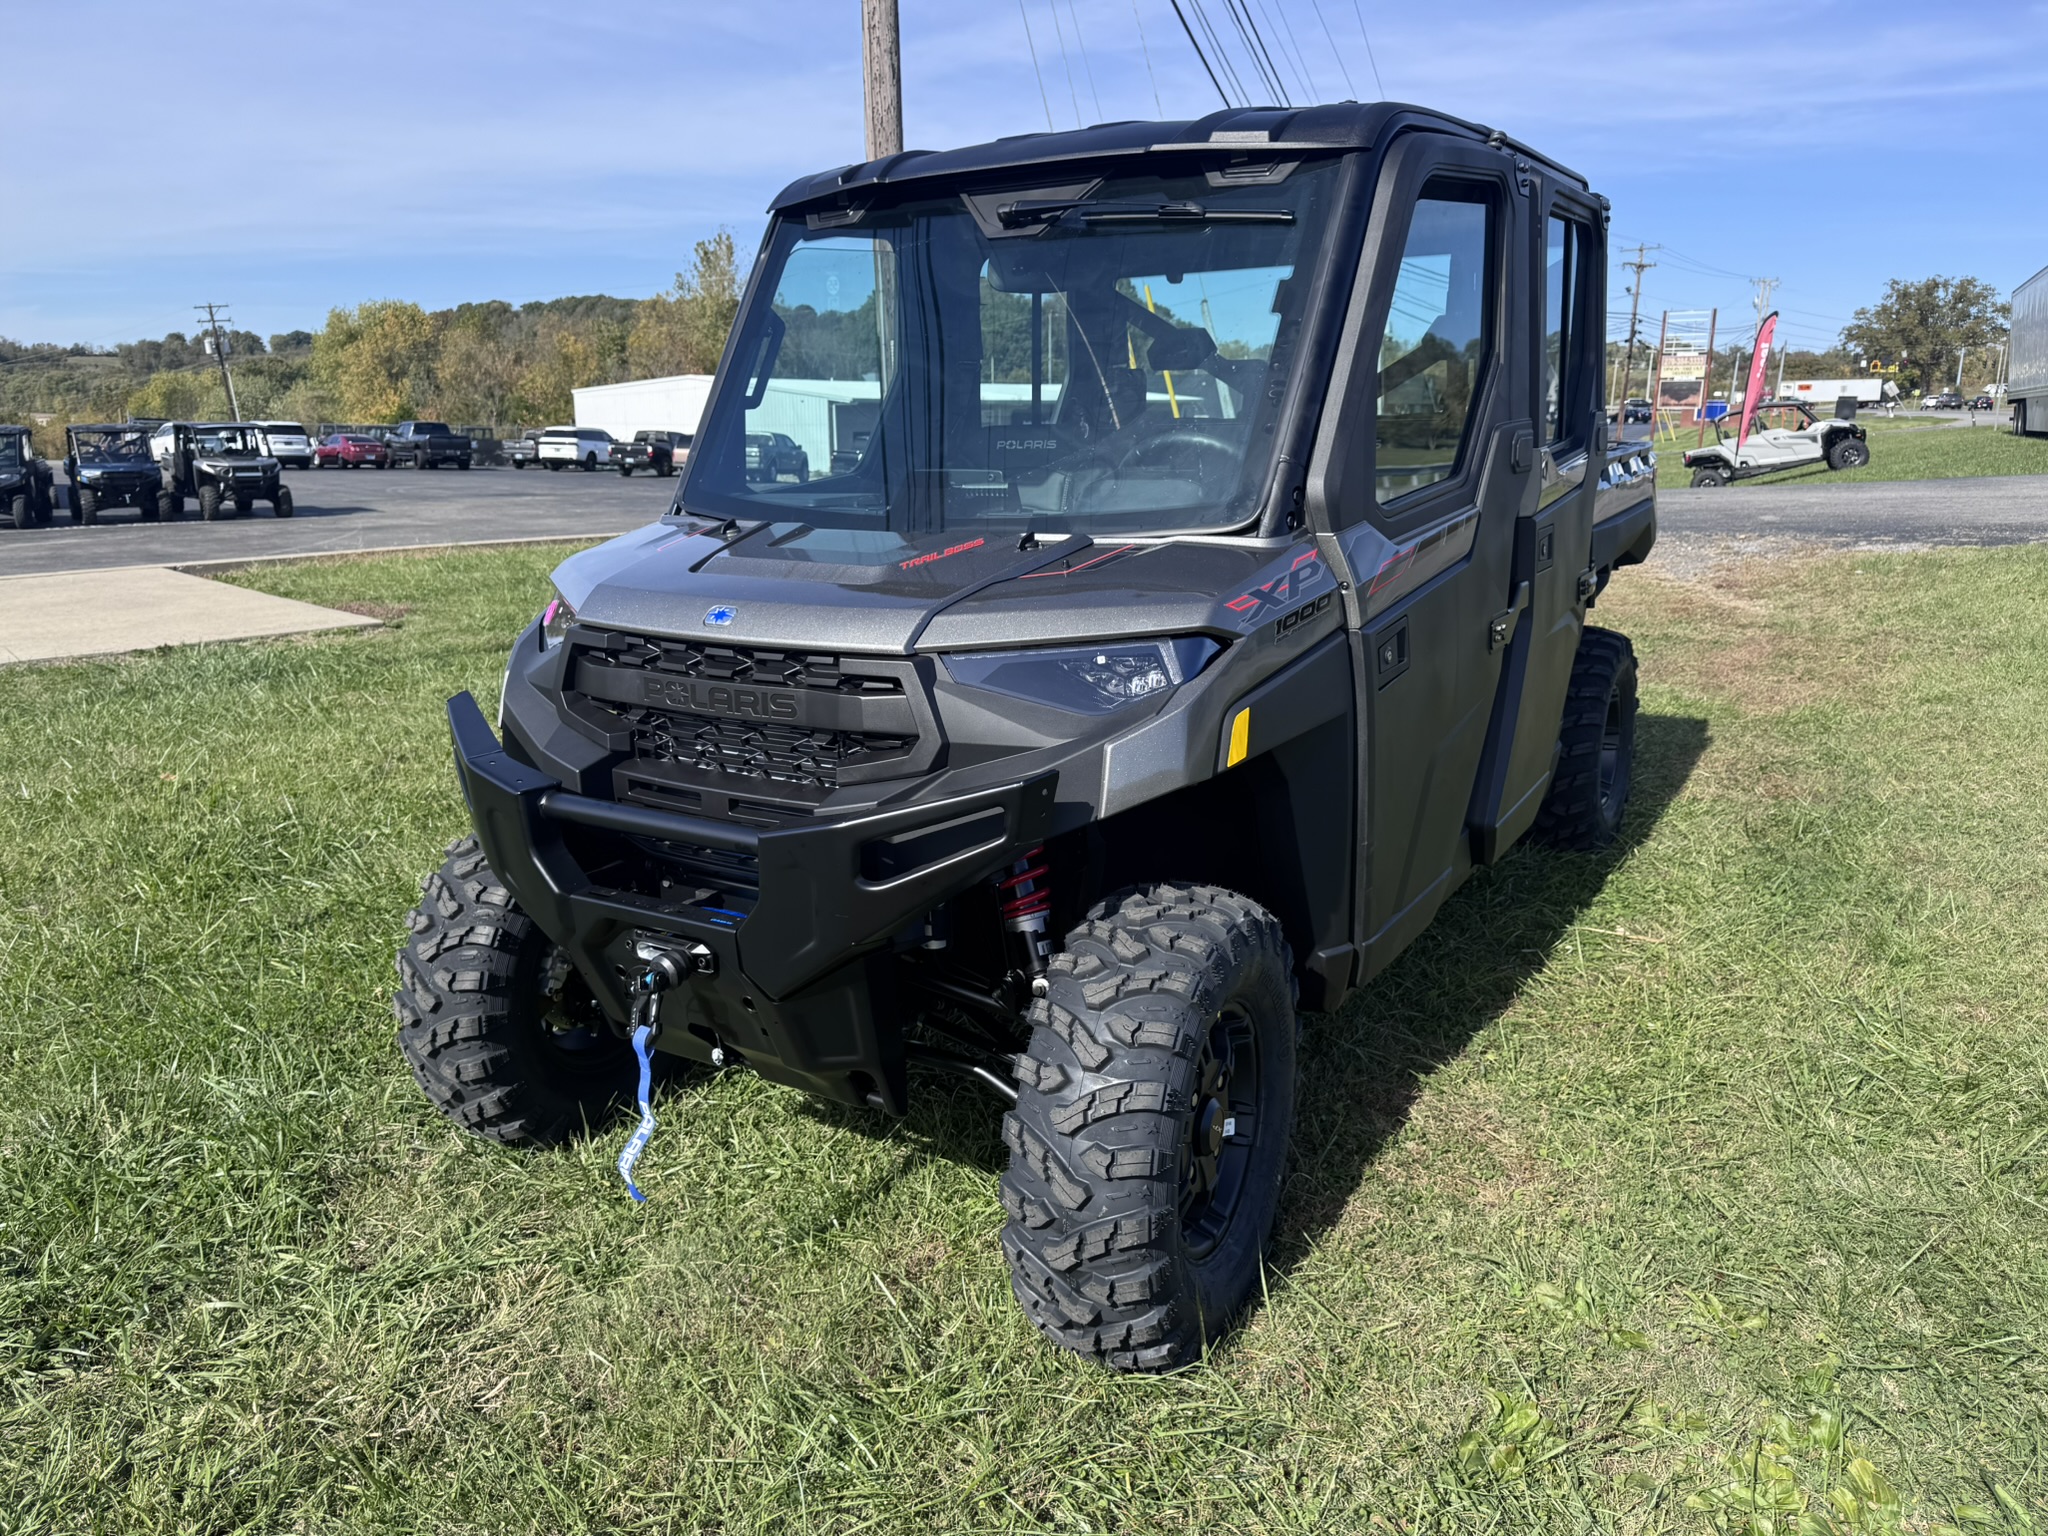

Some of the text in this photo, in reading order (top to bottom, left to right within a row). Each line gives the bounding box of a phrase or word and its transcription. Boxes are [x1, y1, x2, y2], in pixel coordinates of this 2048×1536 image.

[996, 439, 1057, 450] POLARIS
[1234, 556, 1325, 625] XP
[1274, 591, 1332, 636] 1000
[644, 677, 798, 720] POLARIS
